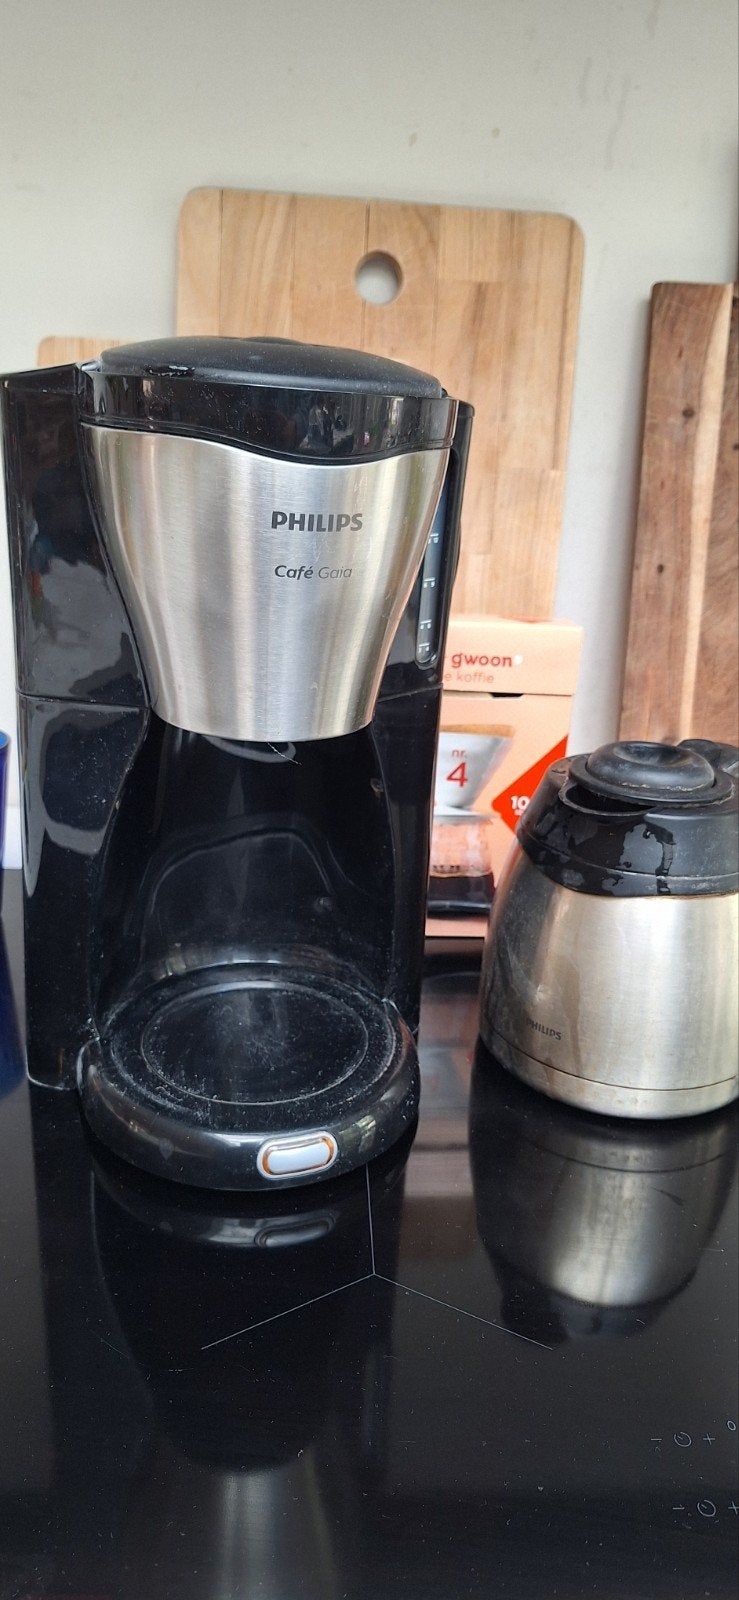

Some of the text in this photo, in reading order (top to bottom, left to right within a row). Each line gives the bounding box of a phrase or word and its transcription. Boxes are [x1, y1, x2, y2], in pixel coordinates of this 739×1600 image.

[271, 511, 363, 532] PHILIPS
[274, 564, 353, 580] Café Gaia
[457, 671, 494, 683] koffie
[446, 762, 468, 787] 4
[526, 1017, 562, 1041] PHILIPS
